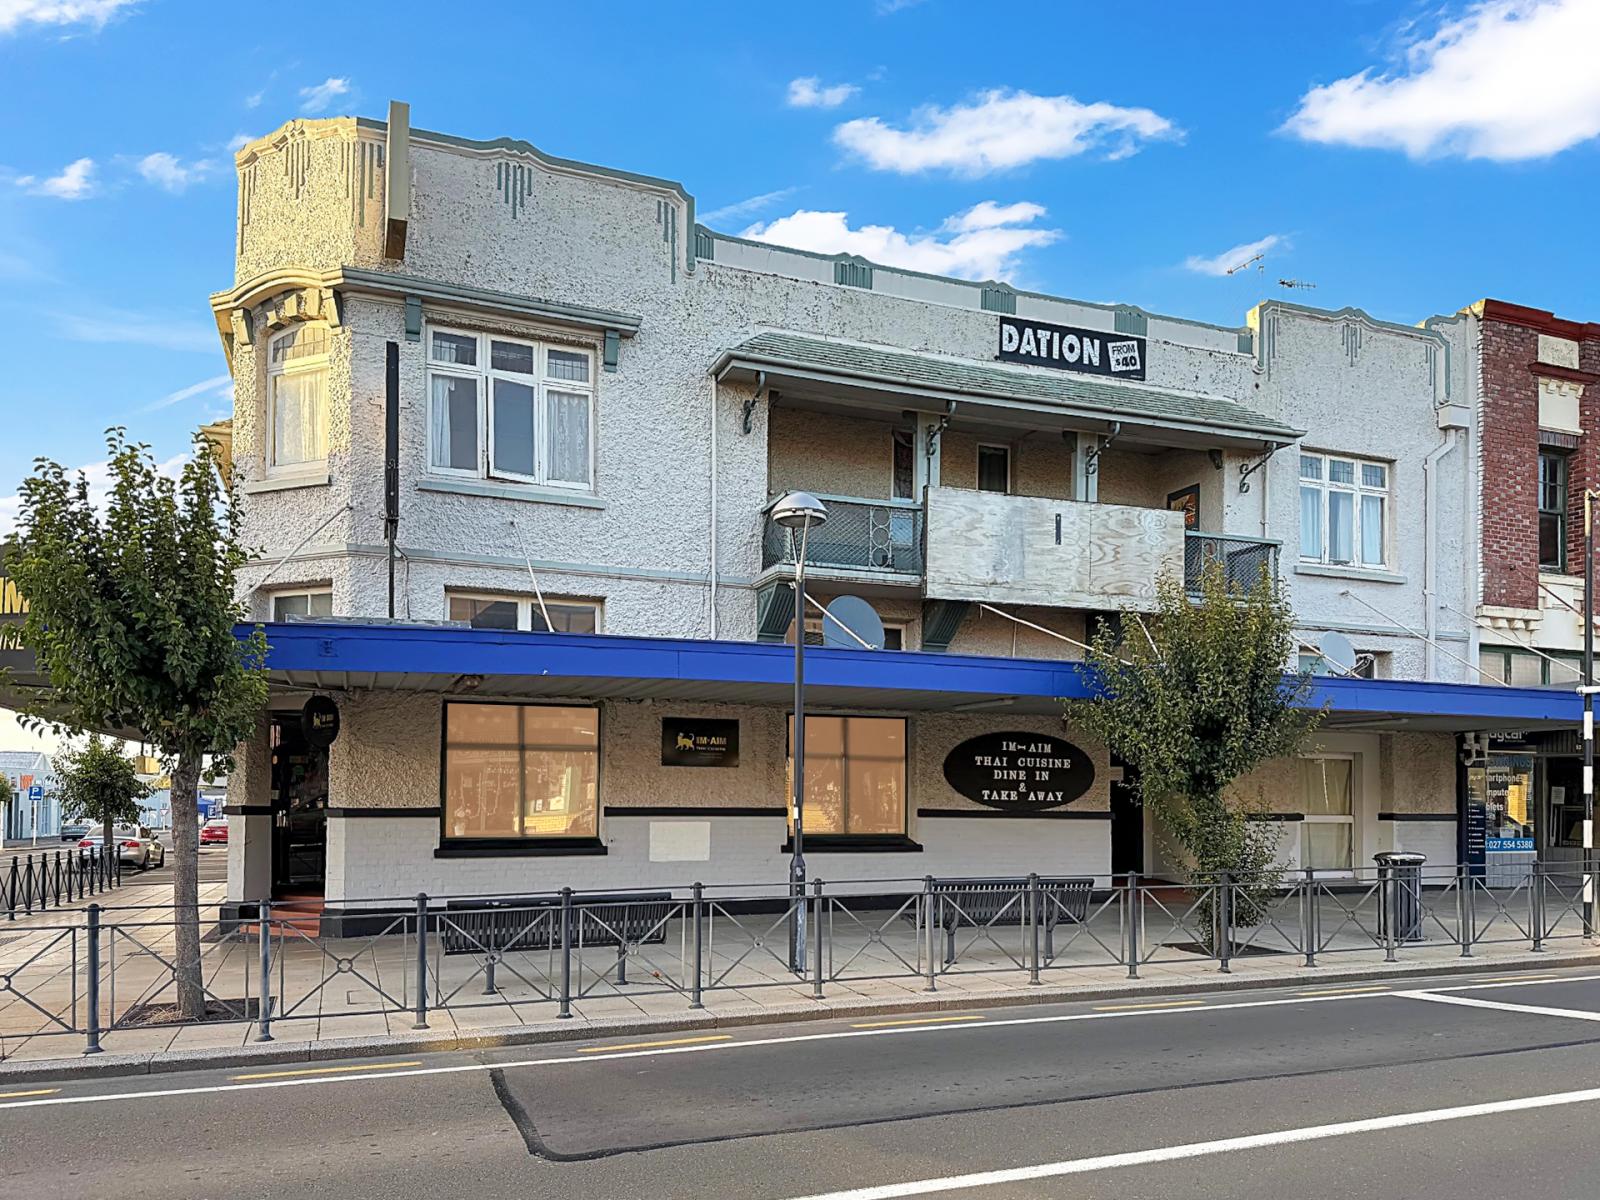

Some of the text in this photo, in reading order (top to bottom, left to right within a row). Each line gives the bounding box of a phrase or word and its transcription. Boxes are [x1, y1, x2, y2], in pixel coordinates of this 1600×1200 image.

[1001, 323, 1101, 367] DATION
[1111, 344, 1136, 356] FROM
[1115, 357, 1137, 369] $40
[974, 756, 1071, 769] THAI CUISINE
[993, 770, 1050, 781] DINE IN
[32, 787, 40, 795] P
[1018, 782, 1027, 793] &
[981, 790, 1064, 801] TAKE AWAY
[1503, 840, 1515, 849] 554
[1516, 840, 1533, 849] 5380
